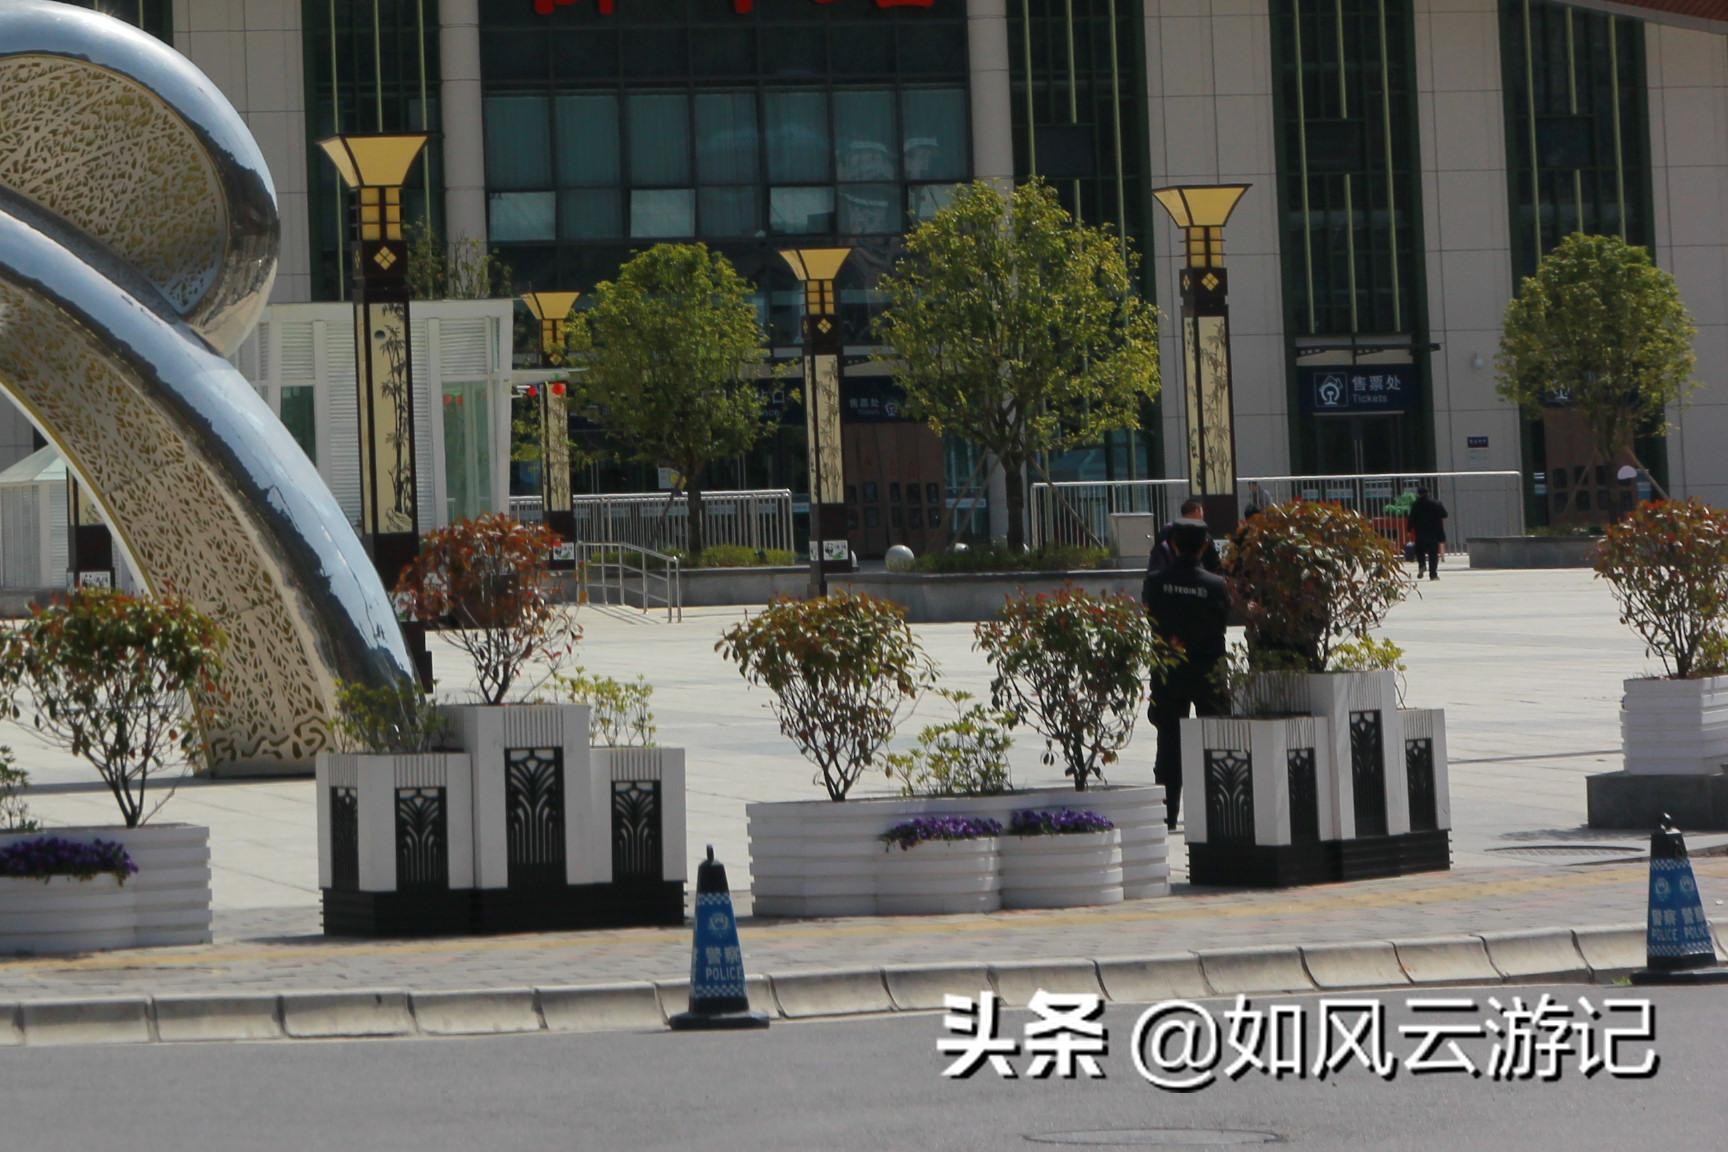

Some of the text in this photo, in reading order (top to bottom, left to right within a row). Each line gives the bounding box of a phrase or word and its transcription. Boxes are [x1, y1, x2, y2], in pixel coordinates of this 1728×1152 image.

[1352, 375, 1401, 391] 售票处
[705, 965, 745, 982] POLICE
